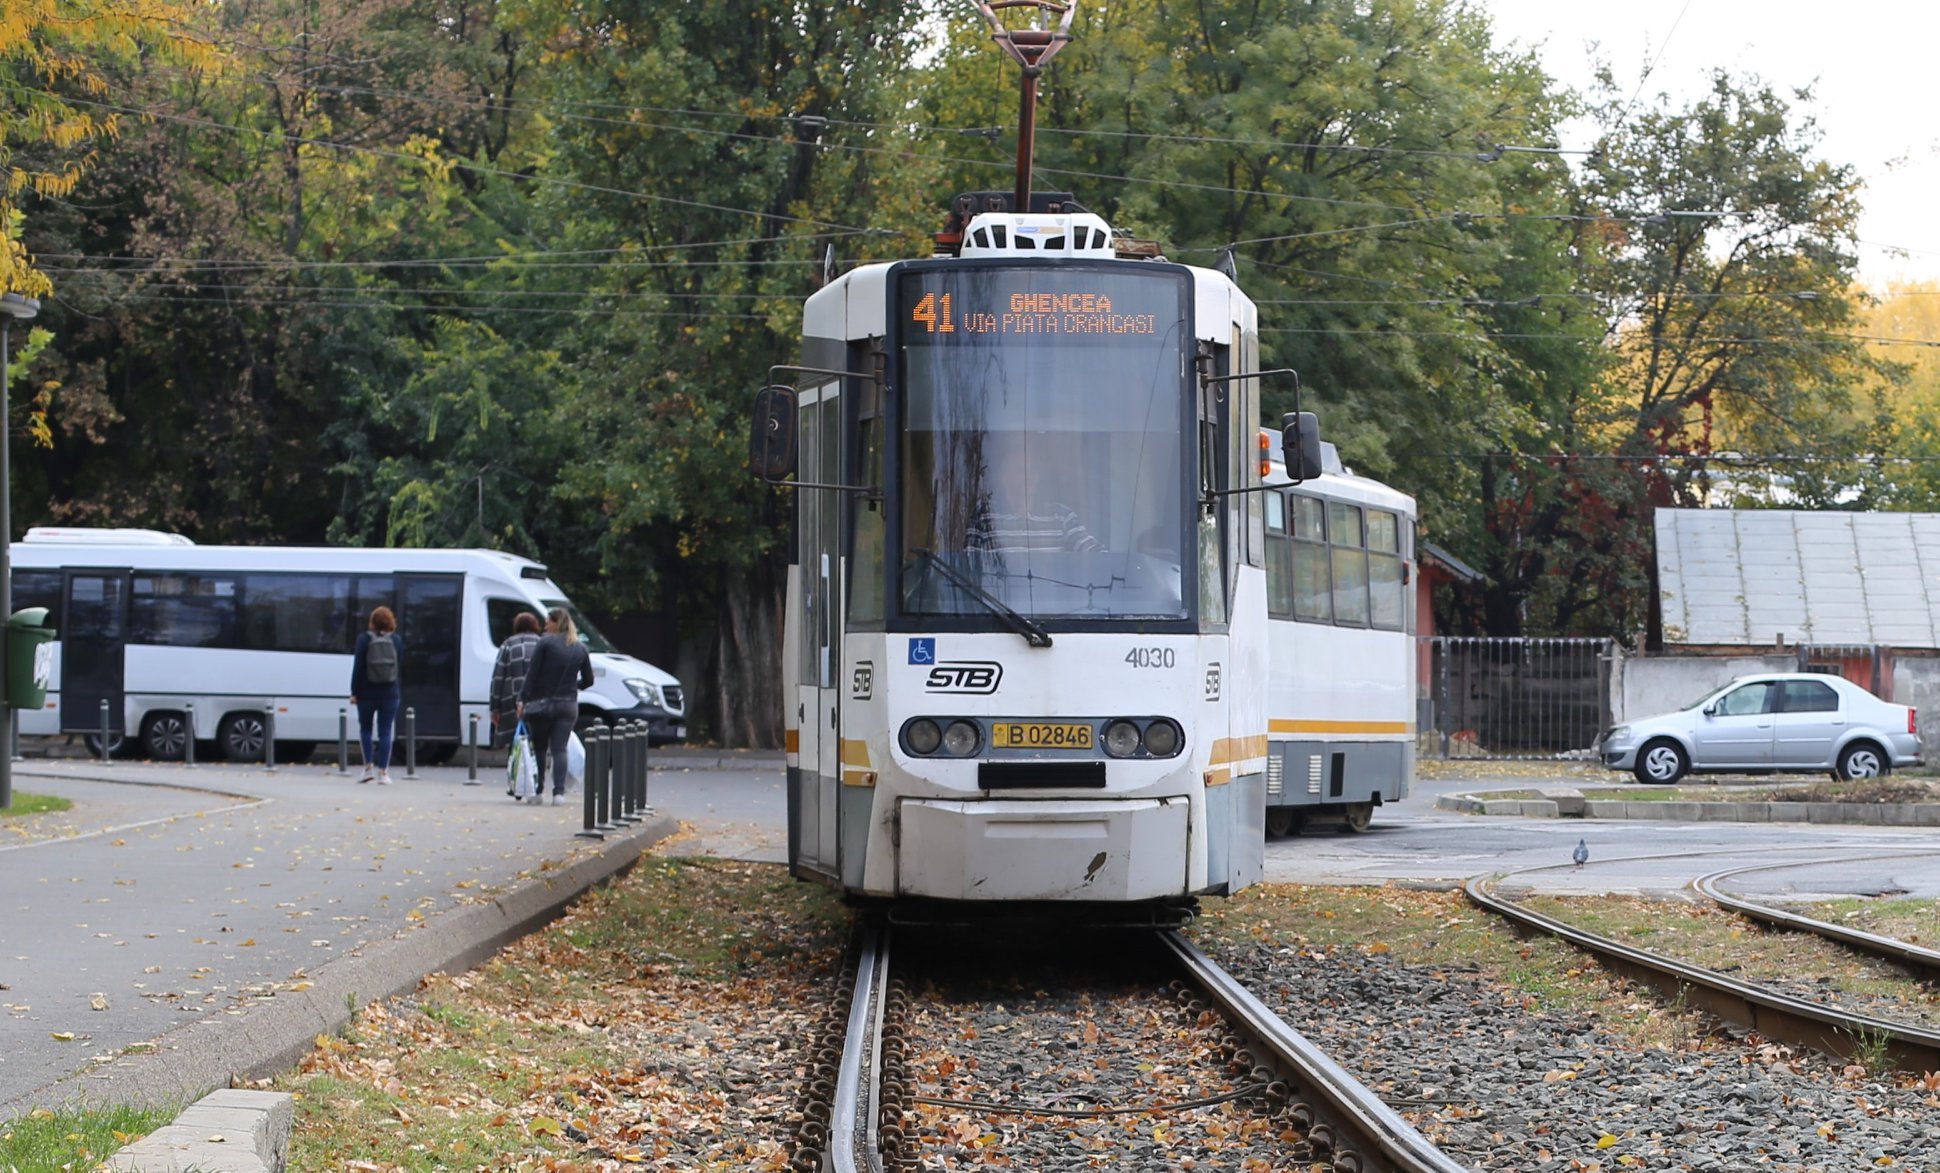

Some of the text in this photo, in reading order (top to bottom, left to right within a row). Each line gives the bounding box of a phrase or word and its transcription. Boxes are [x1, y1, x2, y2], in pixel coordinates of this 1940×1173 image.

[912, 292, 955, 333] 41
[1010, 293, 1112, 313] GHENCEA
[964, 313, 1156, 334] VIA PIATA CRANGASI
[1125, 647, 1175, 668] 4030
[853, 668, 872, 692] STB
[925, 667, 995, 688] STB
[1205, 670, 1219, 694] STB
[1010, 725, 1089, 745] B 02846
